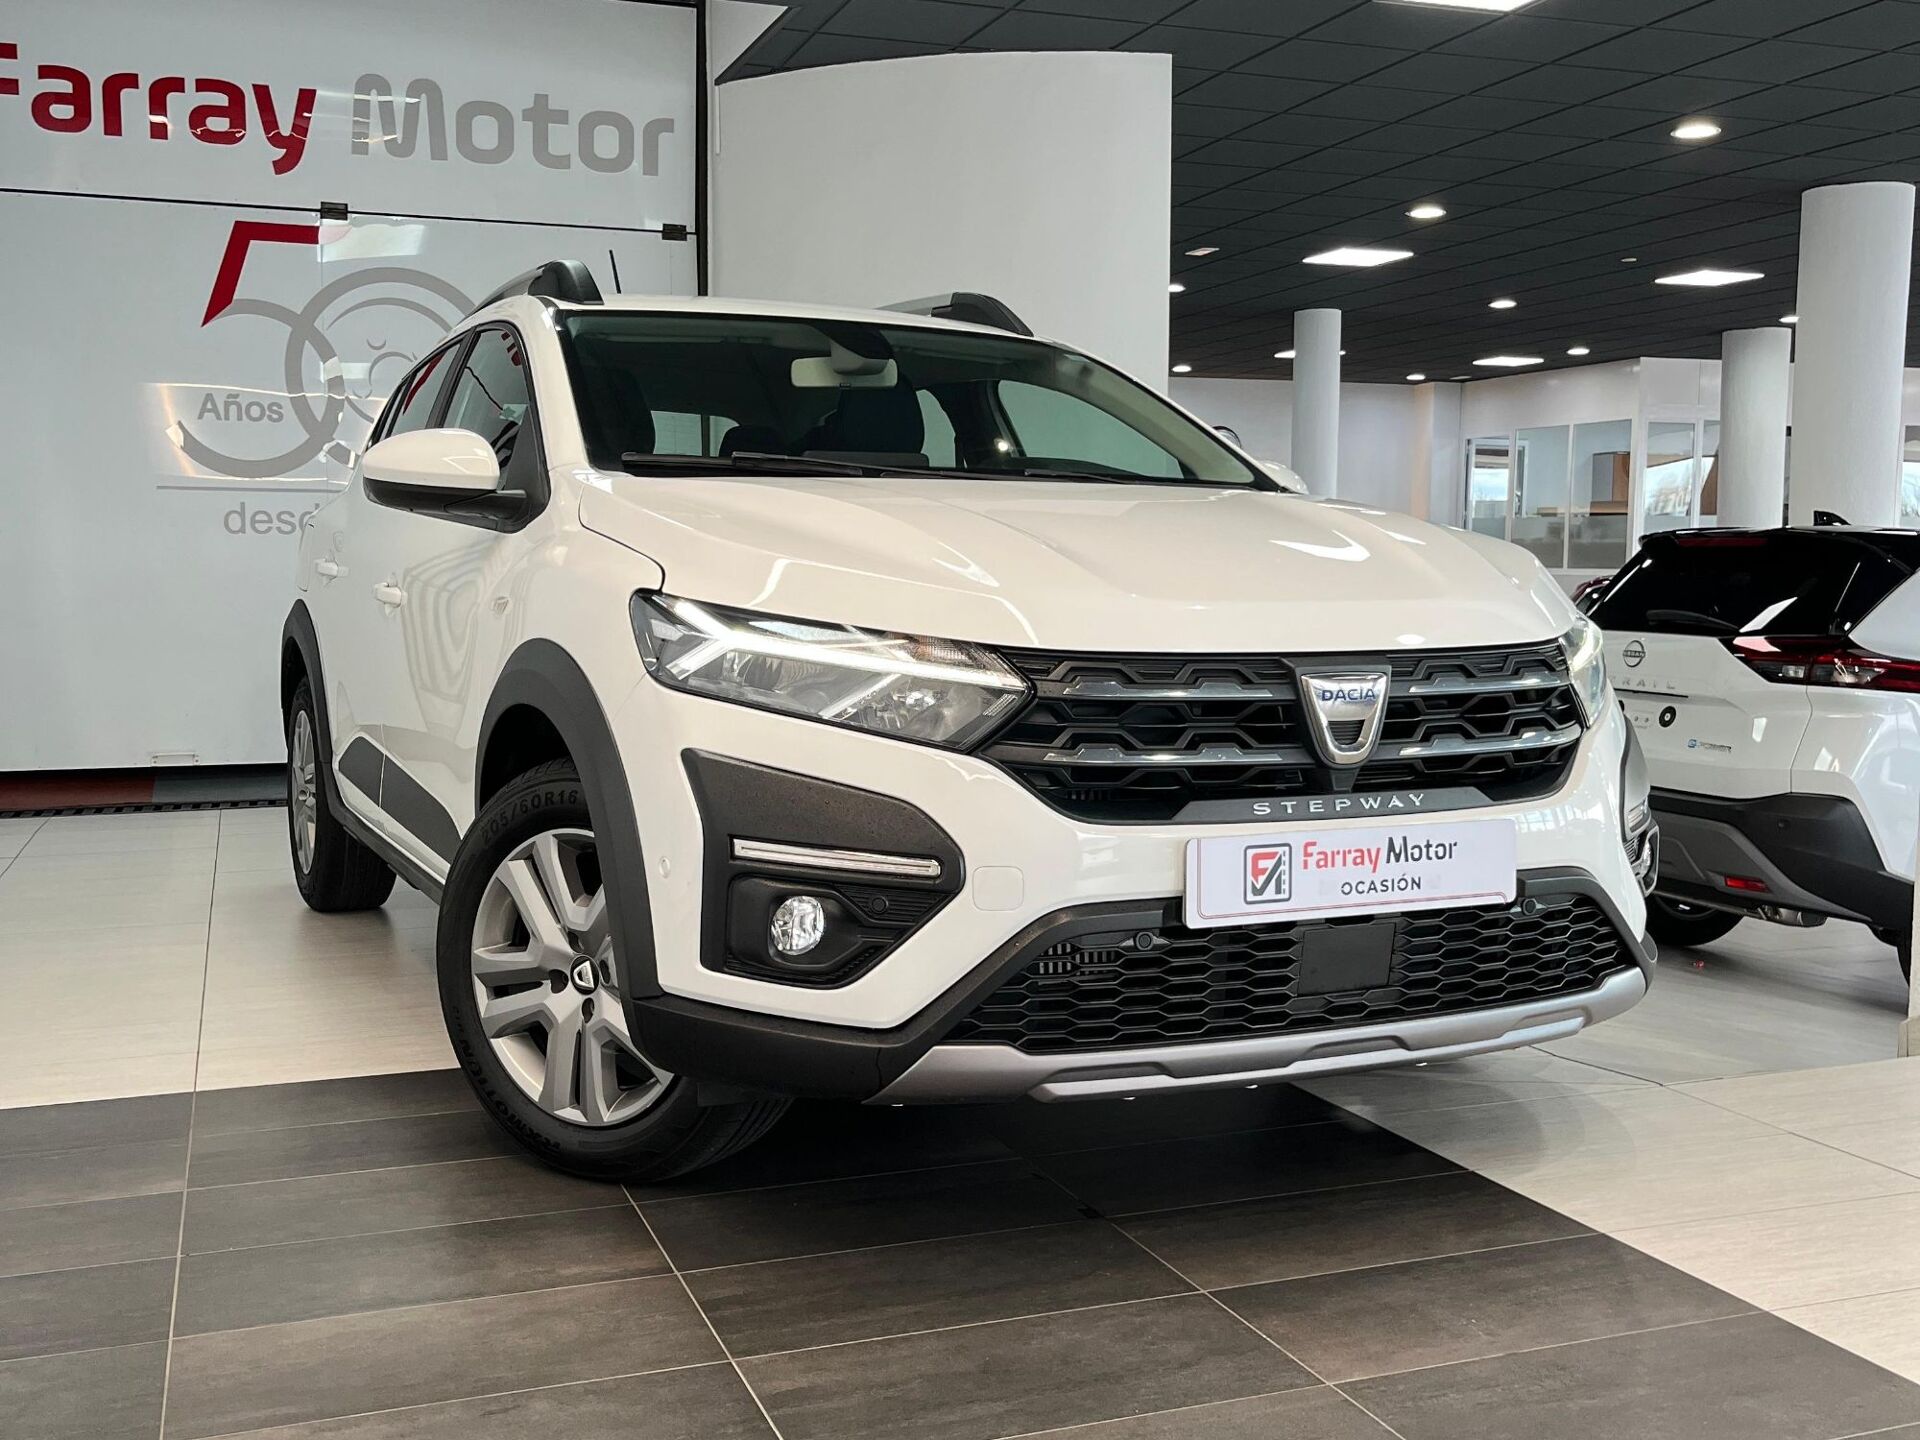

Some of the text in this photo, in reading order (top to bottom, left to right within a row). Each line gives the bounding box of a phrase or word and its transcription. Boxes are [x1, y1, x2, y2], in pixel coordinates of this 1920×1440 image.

[351, 73, 675, 176] Motor
[197, 392, 285, 423] Años
[1321, 688, 1376, 702] DACIA
[481, 789, 579, 846] 205/60R16
[1252, 793, 1425, 816] STEPWAY
[1301, 835, 1458, 874] Farray Motor
[1340, 873, 1422, 896] OCASIÓN
